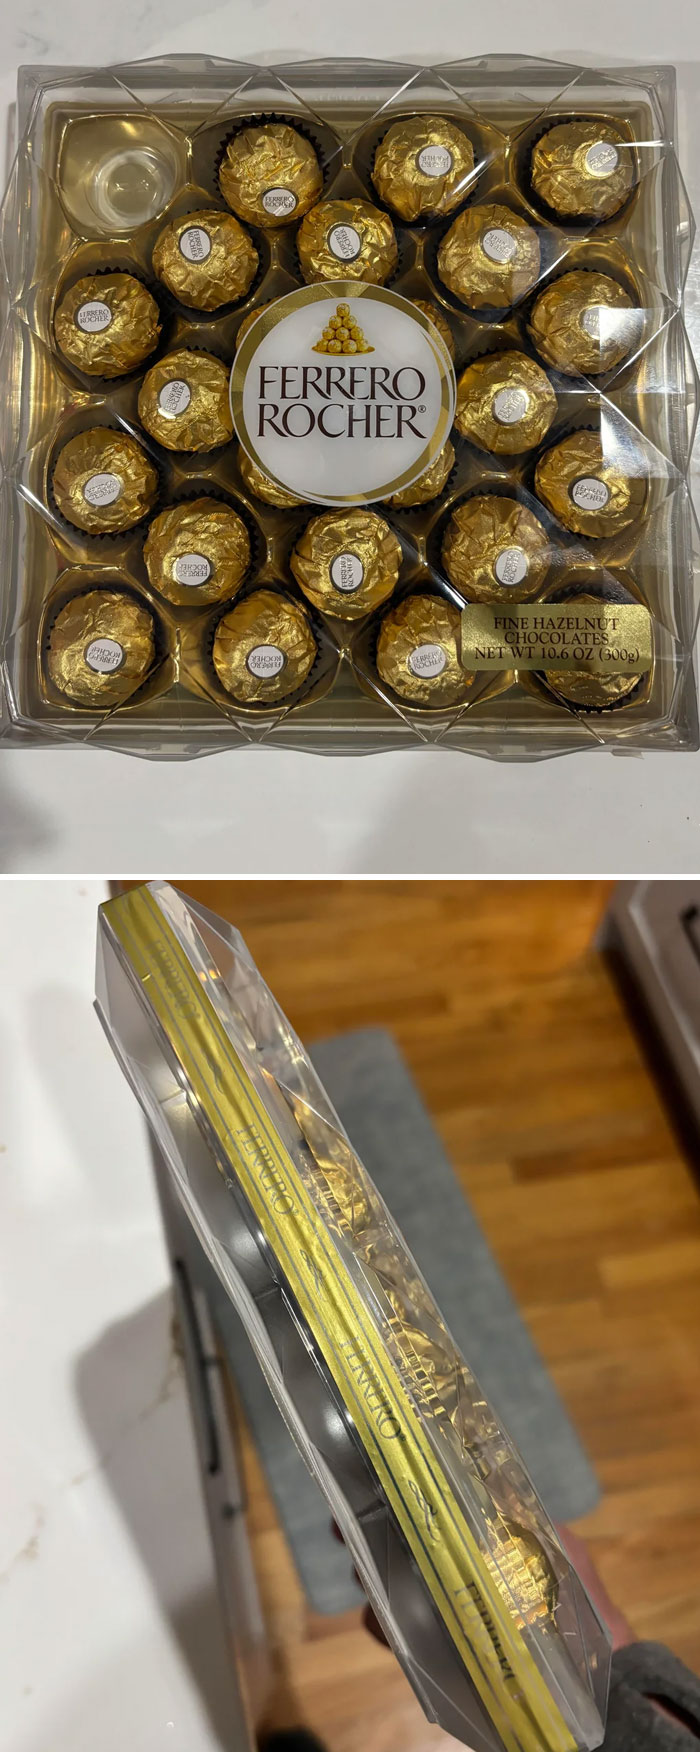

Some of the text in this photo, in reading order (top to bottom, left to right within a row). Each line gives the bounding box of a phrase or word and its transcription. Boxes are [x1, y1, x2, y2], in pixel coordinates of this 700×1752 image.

[188, 231, 198, 258] ROCHER
[194, 230, 204, 258] FERRERO
[258, 366, 426, 401] FERRERO
[180, 563, 208, 571] ROCHER
[494, 617, 619, 631] FINE HAZELNUT
[504, 631, 609, 645] CHOCOLATES
[88, 652, 119, 665] FERRERO
[91, 646, 121, 659] ROCHER
[475, 647, 640, 665] NET WT 10.6 OZ (300g)
[250, 661, 281, 669] FERRERO
